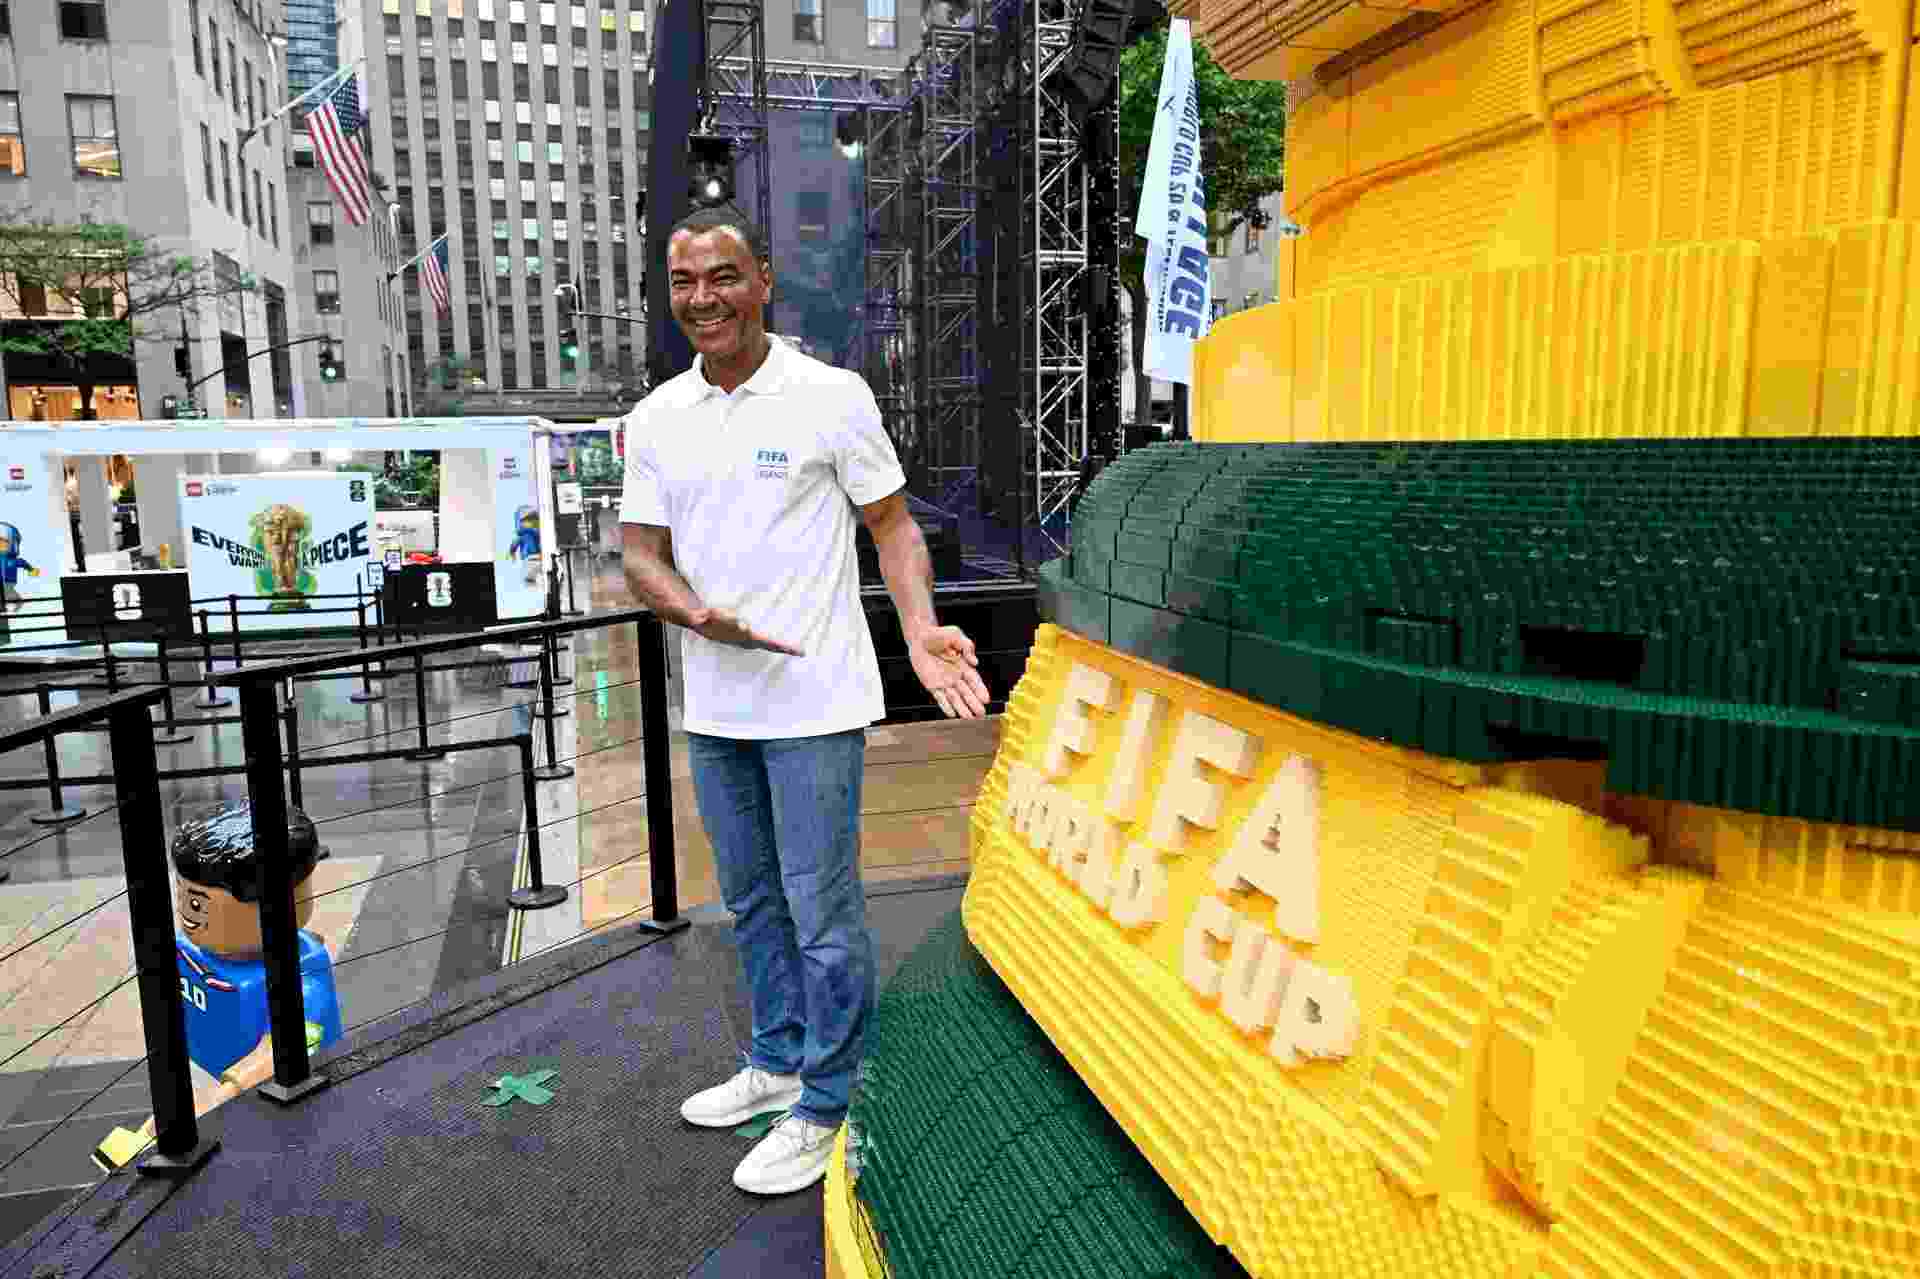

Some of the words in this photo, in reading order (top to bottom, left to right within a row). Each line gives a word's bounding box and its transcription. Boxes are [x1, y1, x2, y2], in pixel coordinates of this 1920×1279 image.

[757, 449, 789, 463] FIFA
[311, 521, 369, 566] PIECE
[1045, 663, 1322, 944] FIFA
[1006, 763, 1162, 926] WORLD
[1182, 896, 1359, 1064] CUP
